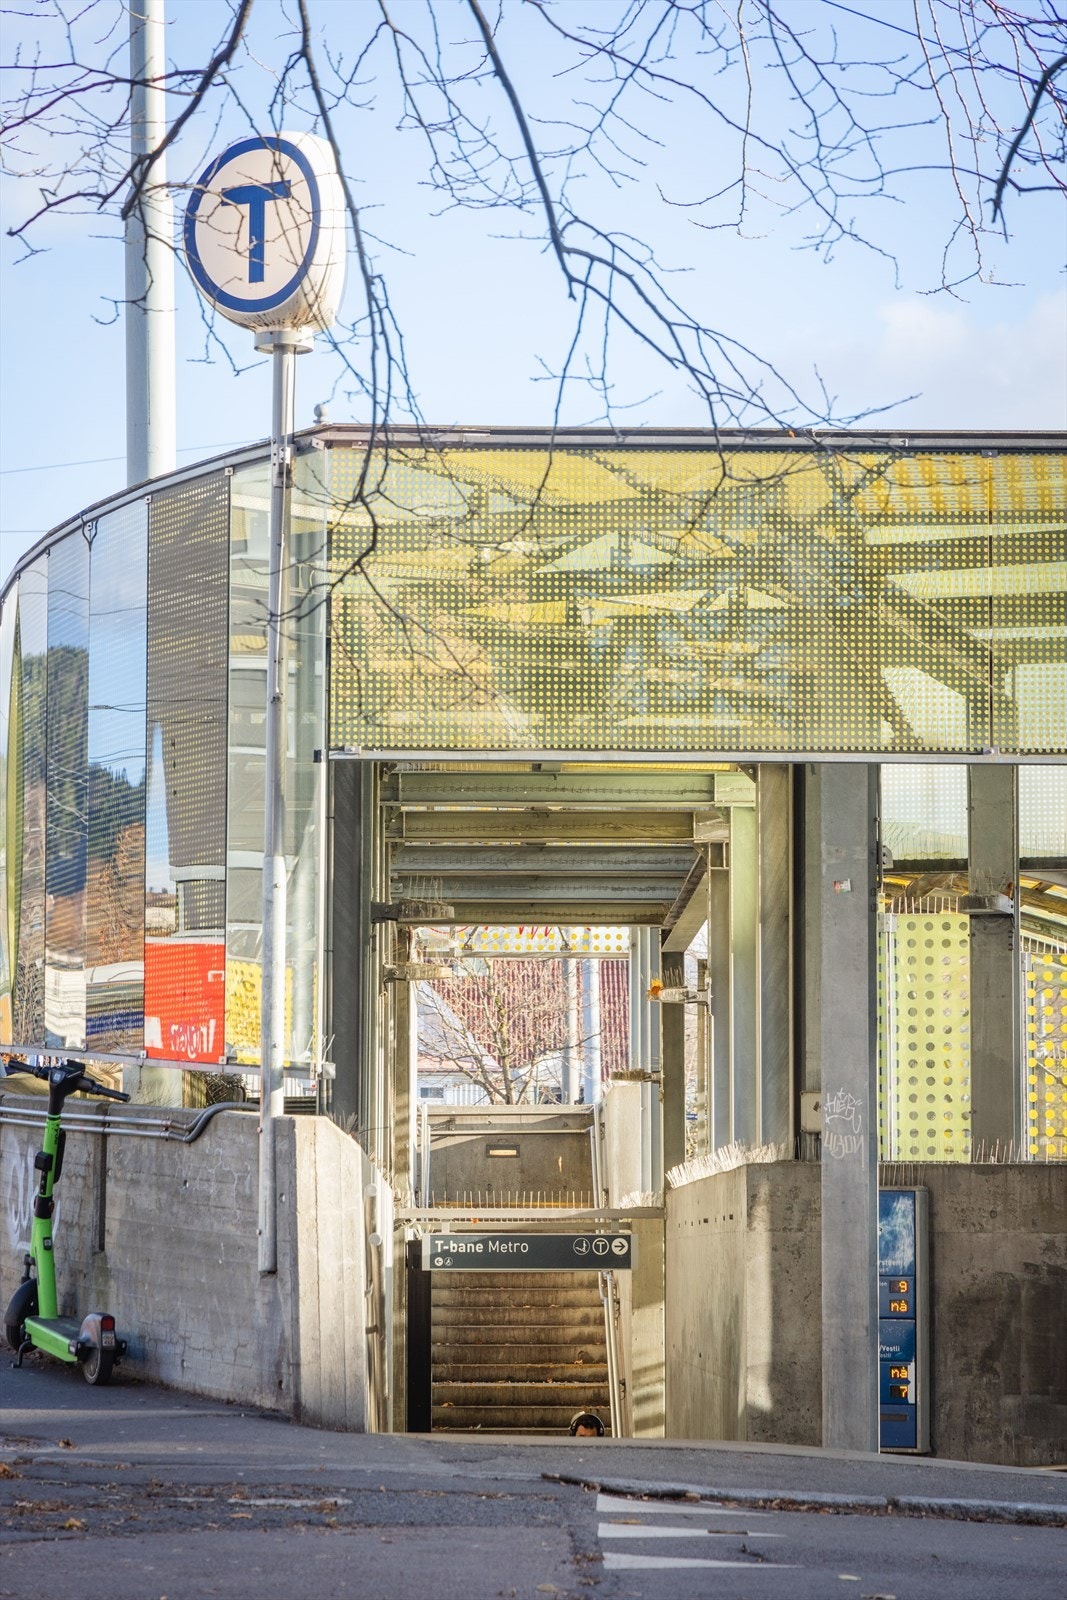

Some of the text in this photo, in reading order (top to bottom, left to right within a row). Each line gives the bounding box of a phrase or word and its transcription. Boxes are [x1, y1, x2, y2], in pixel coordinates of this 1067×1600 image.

[221, 180, 292, 284] T
[434, 1240, 484, 1253] T-bane
[488, 1240, 529, 1253] Metro
[899, 1280, 908, 1293] 9
[899, 1385, 908, 1398] 7
